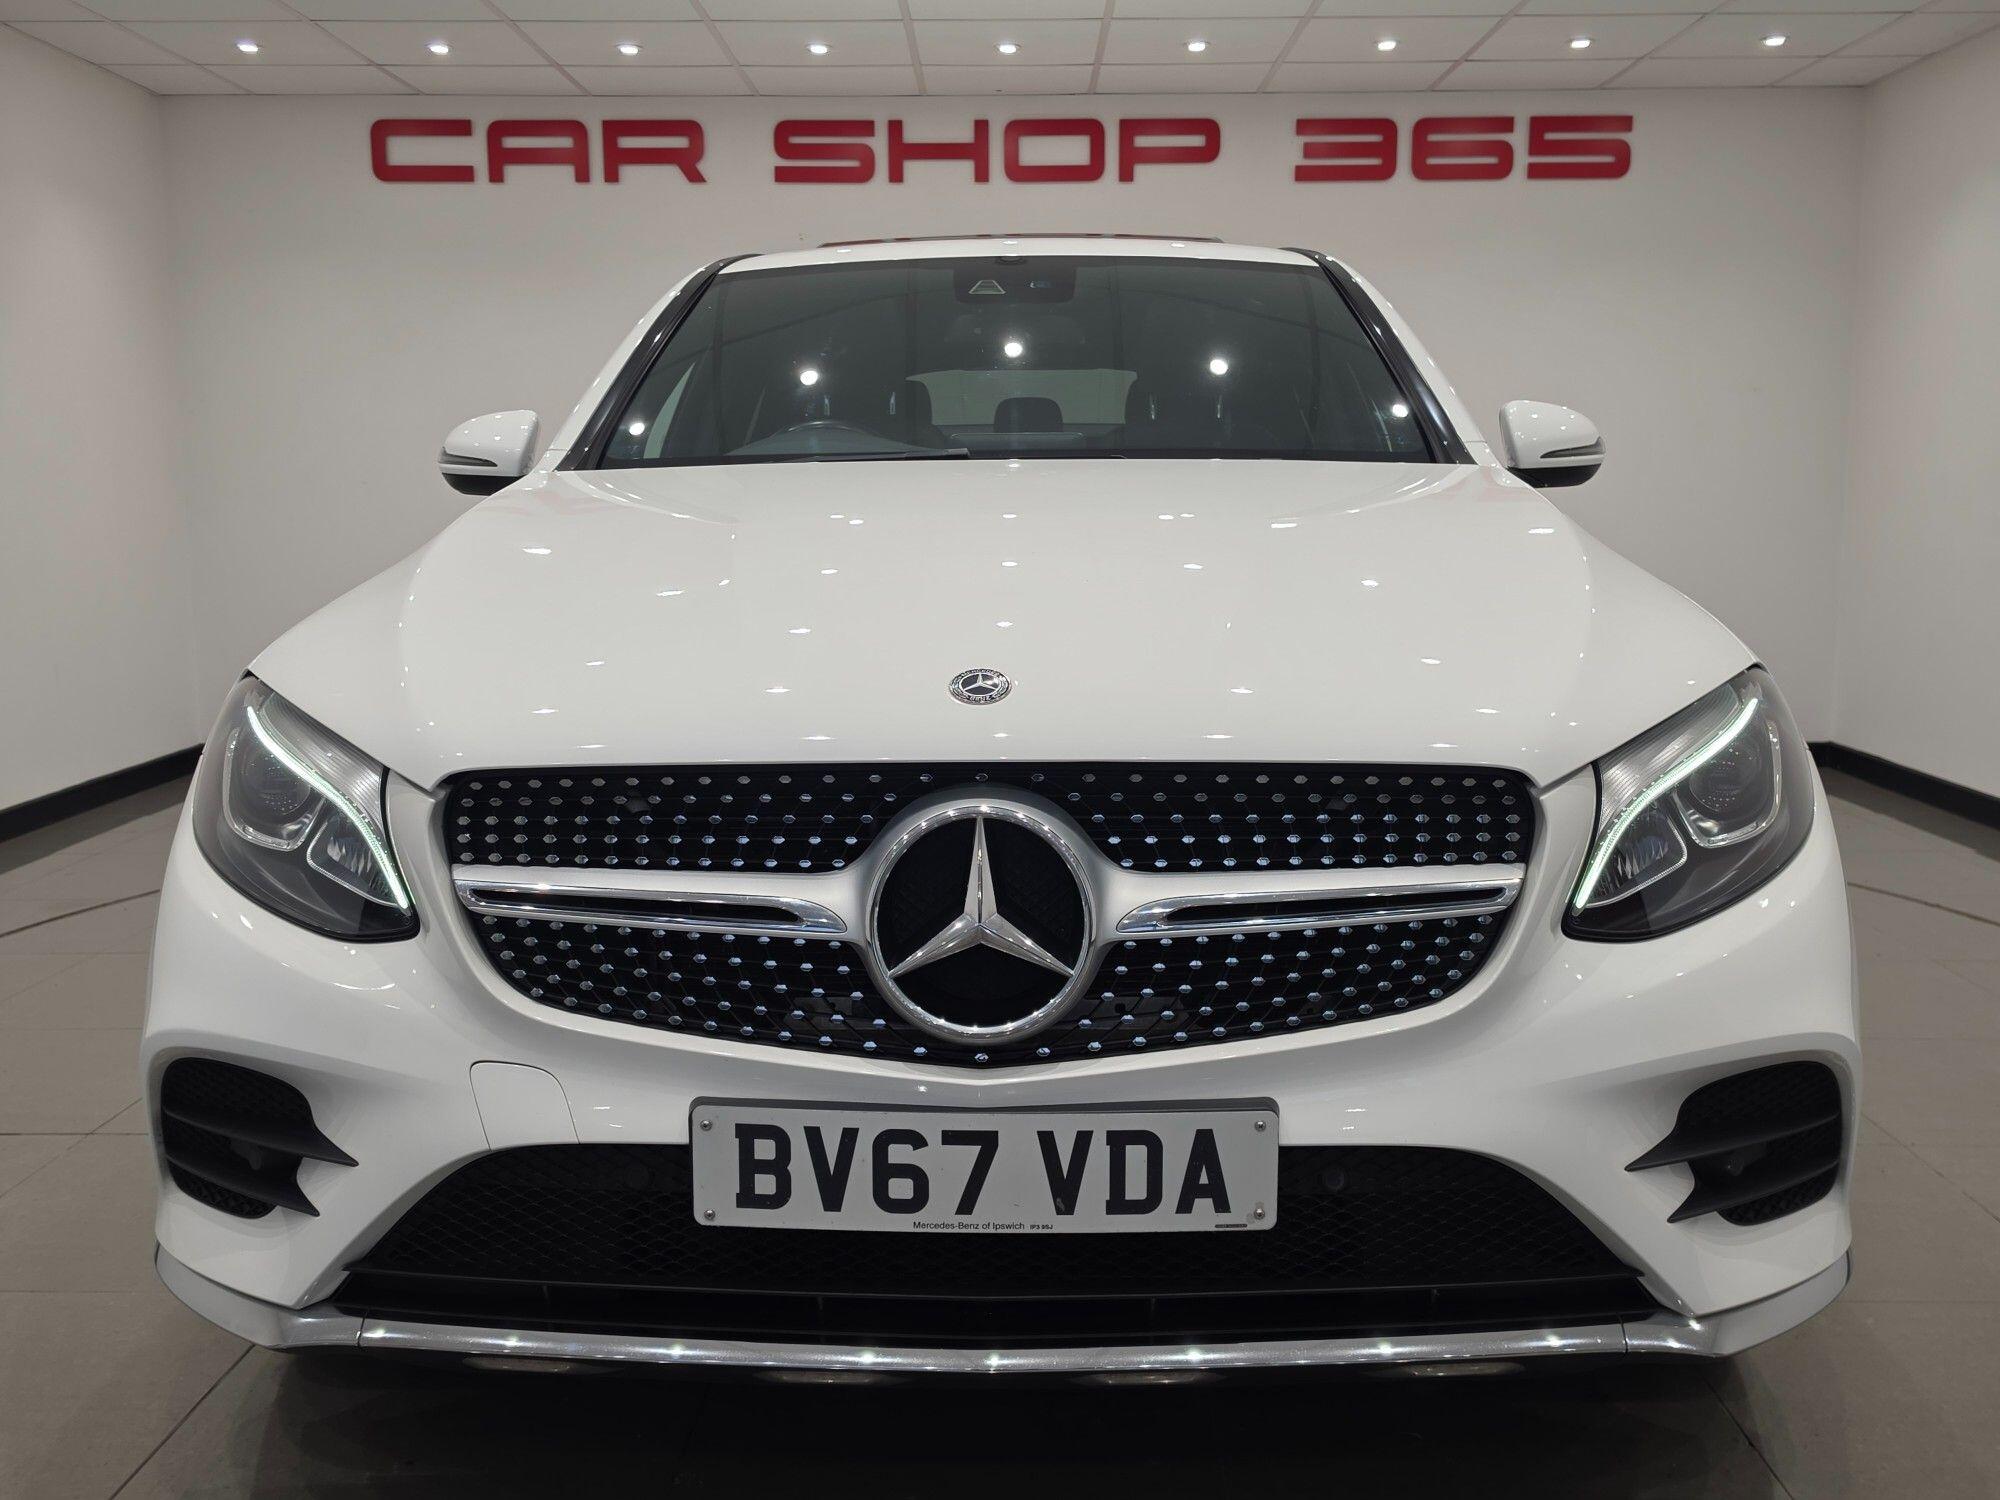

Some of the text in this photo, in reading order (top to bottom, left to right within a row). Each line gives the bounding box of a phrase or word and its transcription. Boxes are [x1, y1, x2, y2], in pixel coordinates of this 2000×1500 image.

[370, 114, 1633, 184] CAR SHOP 365
[734, 1122, 1232, 1216] BV67 VDA
[912, 1221, 980, 1230] Mercedes-Benz
[981, 1221, 991, 1230] of
[992, 1221, 1025, 1231] Ipswich
